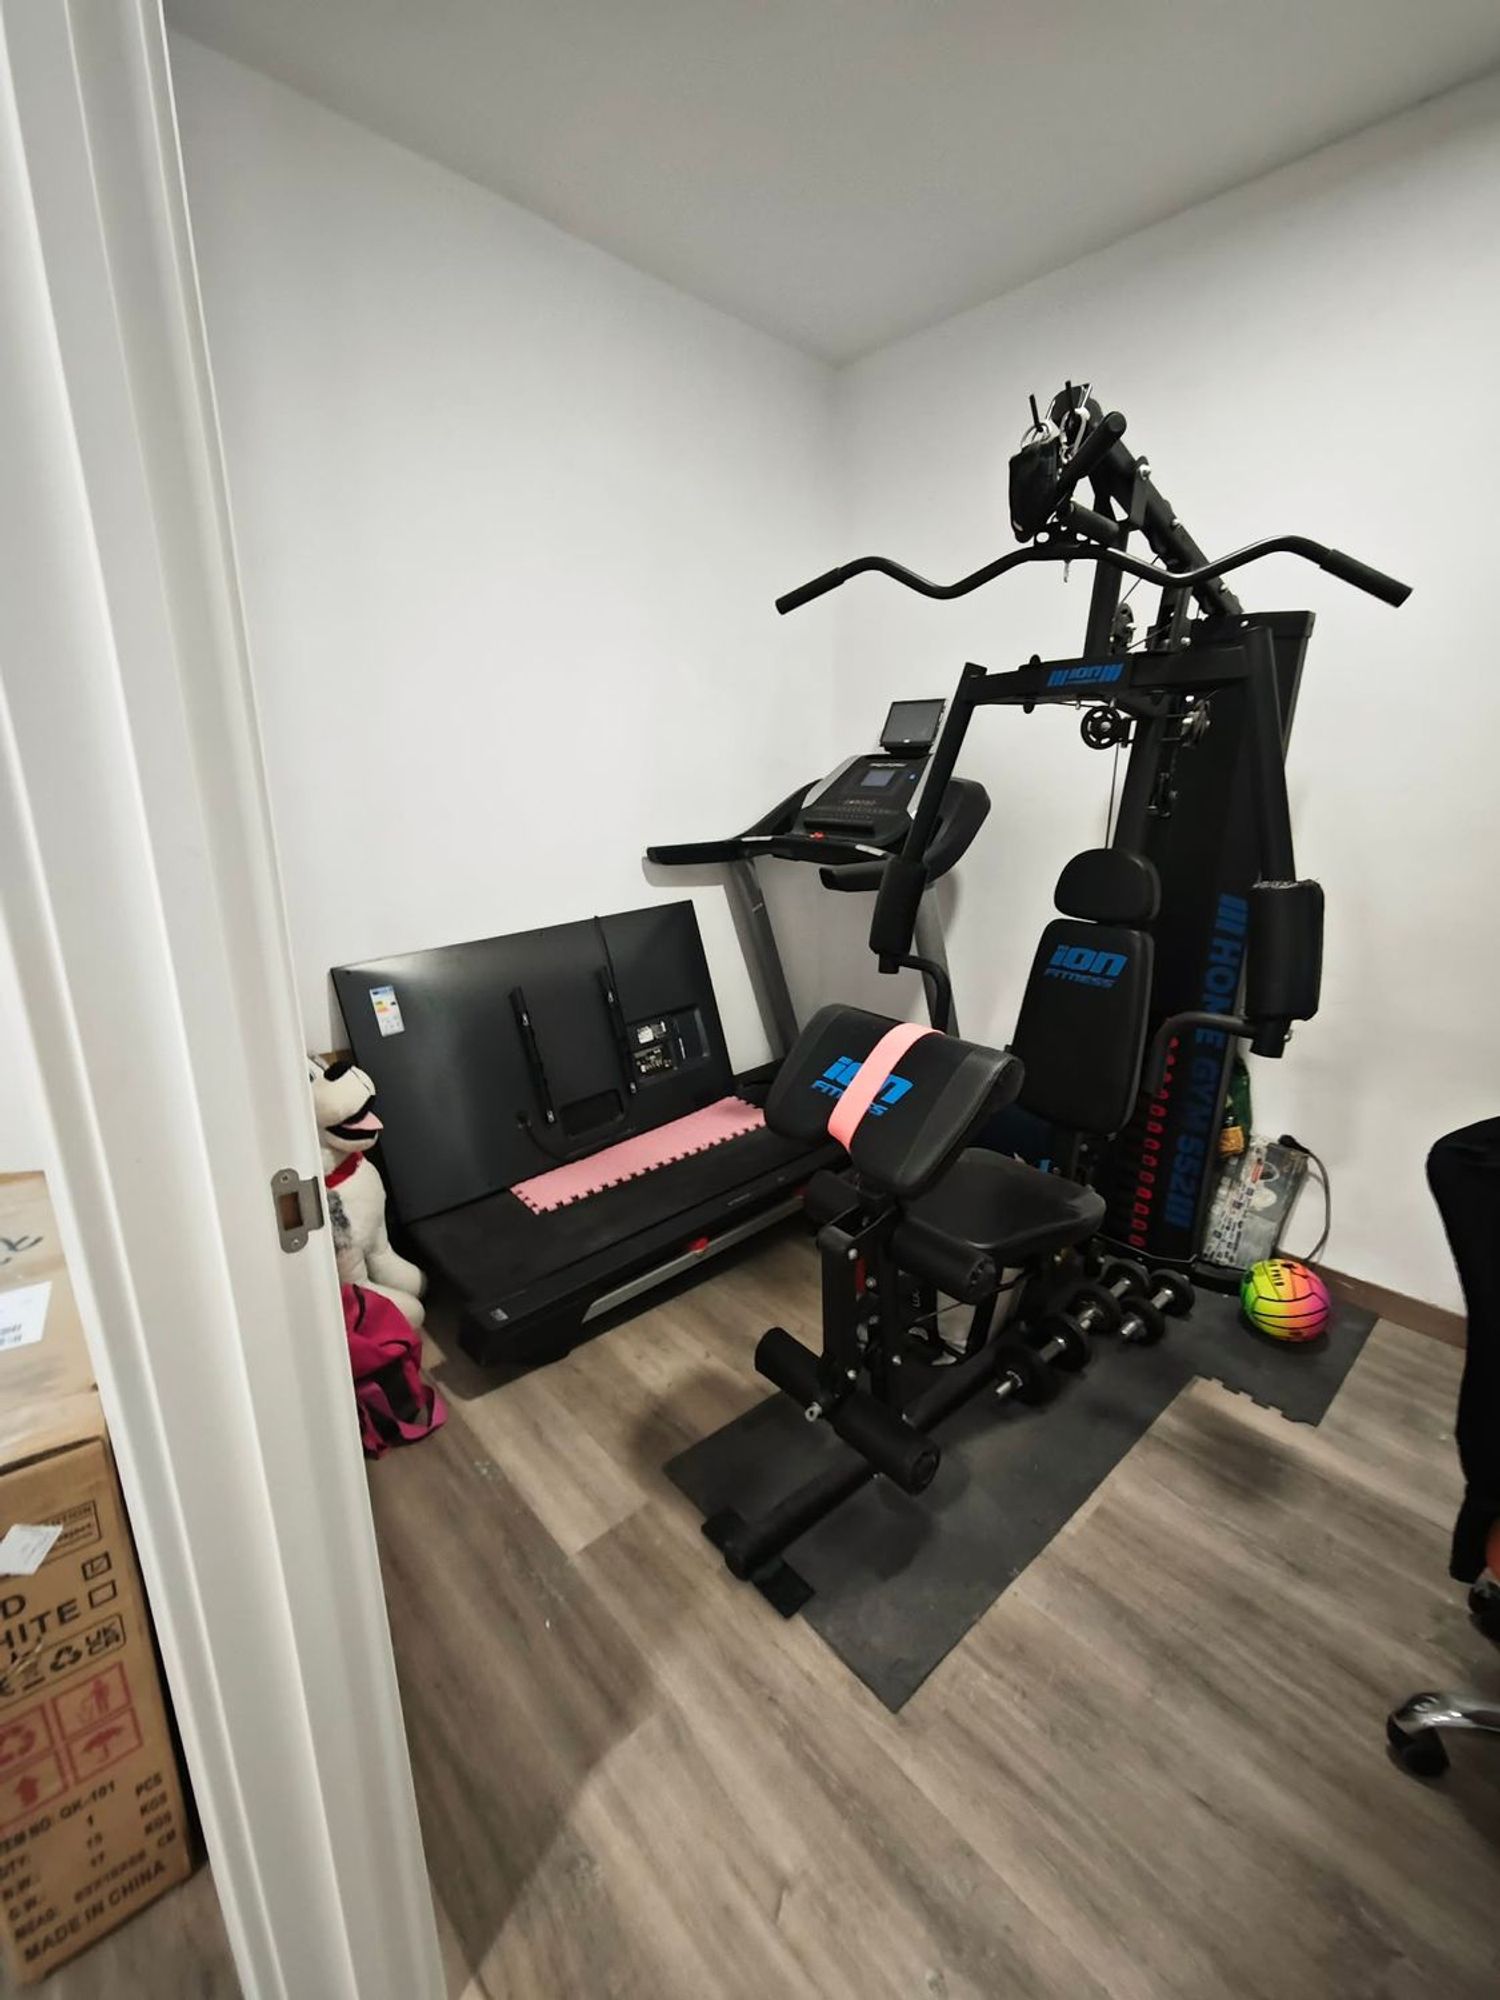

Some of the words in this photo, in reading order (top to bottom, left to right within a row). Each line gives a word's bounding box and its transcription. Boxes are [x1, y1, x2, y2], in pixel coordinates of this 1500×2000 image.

[24, 1916, 81, 1962] MADE
[85, 1900, 105, 1923] IN
[108, 1859, 167, 1907] CHINA
